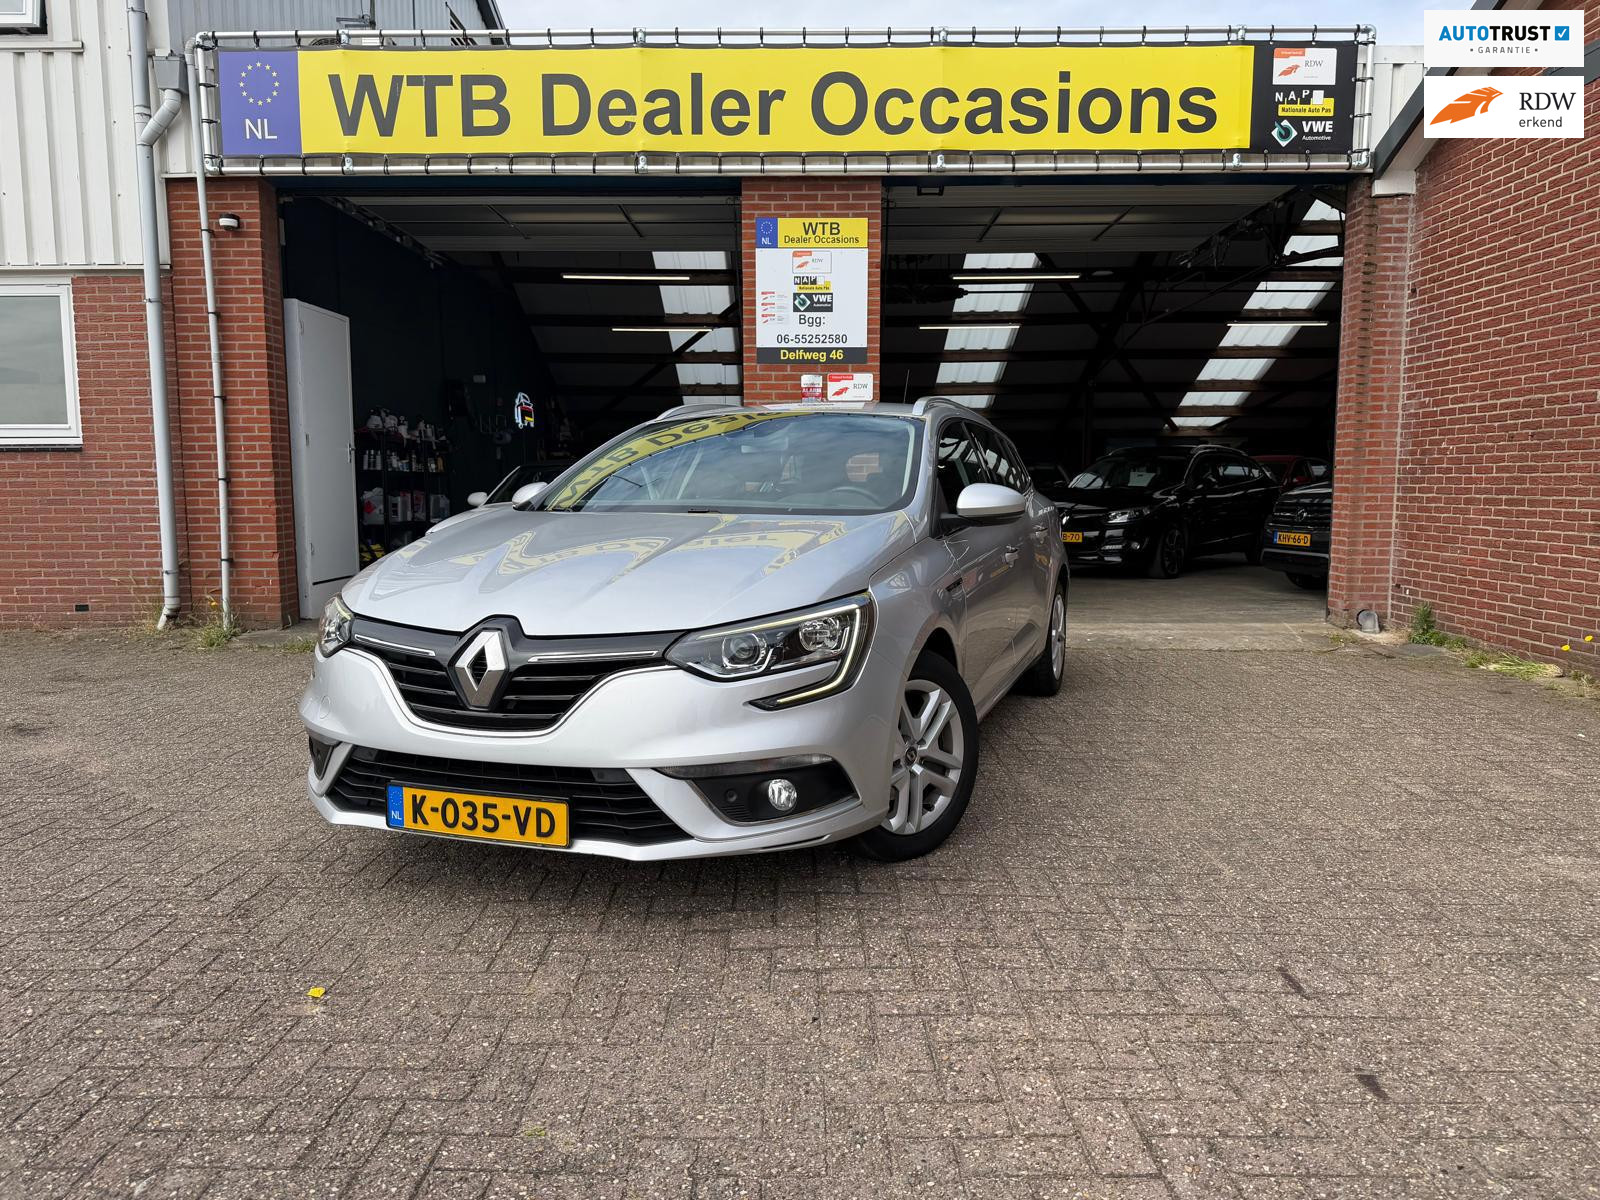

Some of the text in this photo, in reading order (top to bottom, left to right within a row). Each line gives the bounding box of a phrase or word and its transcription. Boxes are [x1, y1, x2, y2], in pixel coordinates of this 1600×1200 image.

[1304, 60, 1323, 68] RDW
[327, 70, 1218, 138] WTB Dealer Occasions
[245, 118, 278, 140] NL
[1302, 121, 1333, 133] VWE
[802, 222, 841, 235] WTB
[761, 237, 772, 245] NL
[783, 235, 860, 244] Dealer Occasions
[798, 314, 826, 327] Bgg:
[776, 334, 848, 344] 06-55252580
[780, 349, 844, 362] Delfweg 46
[1278, 533, 1309, 544] KHV-66-D
[391, 811, 402, 821] NL
[411, 794, 556, 838] K-035-VD
